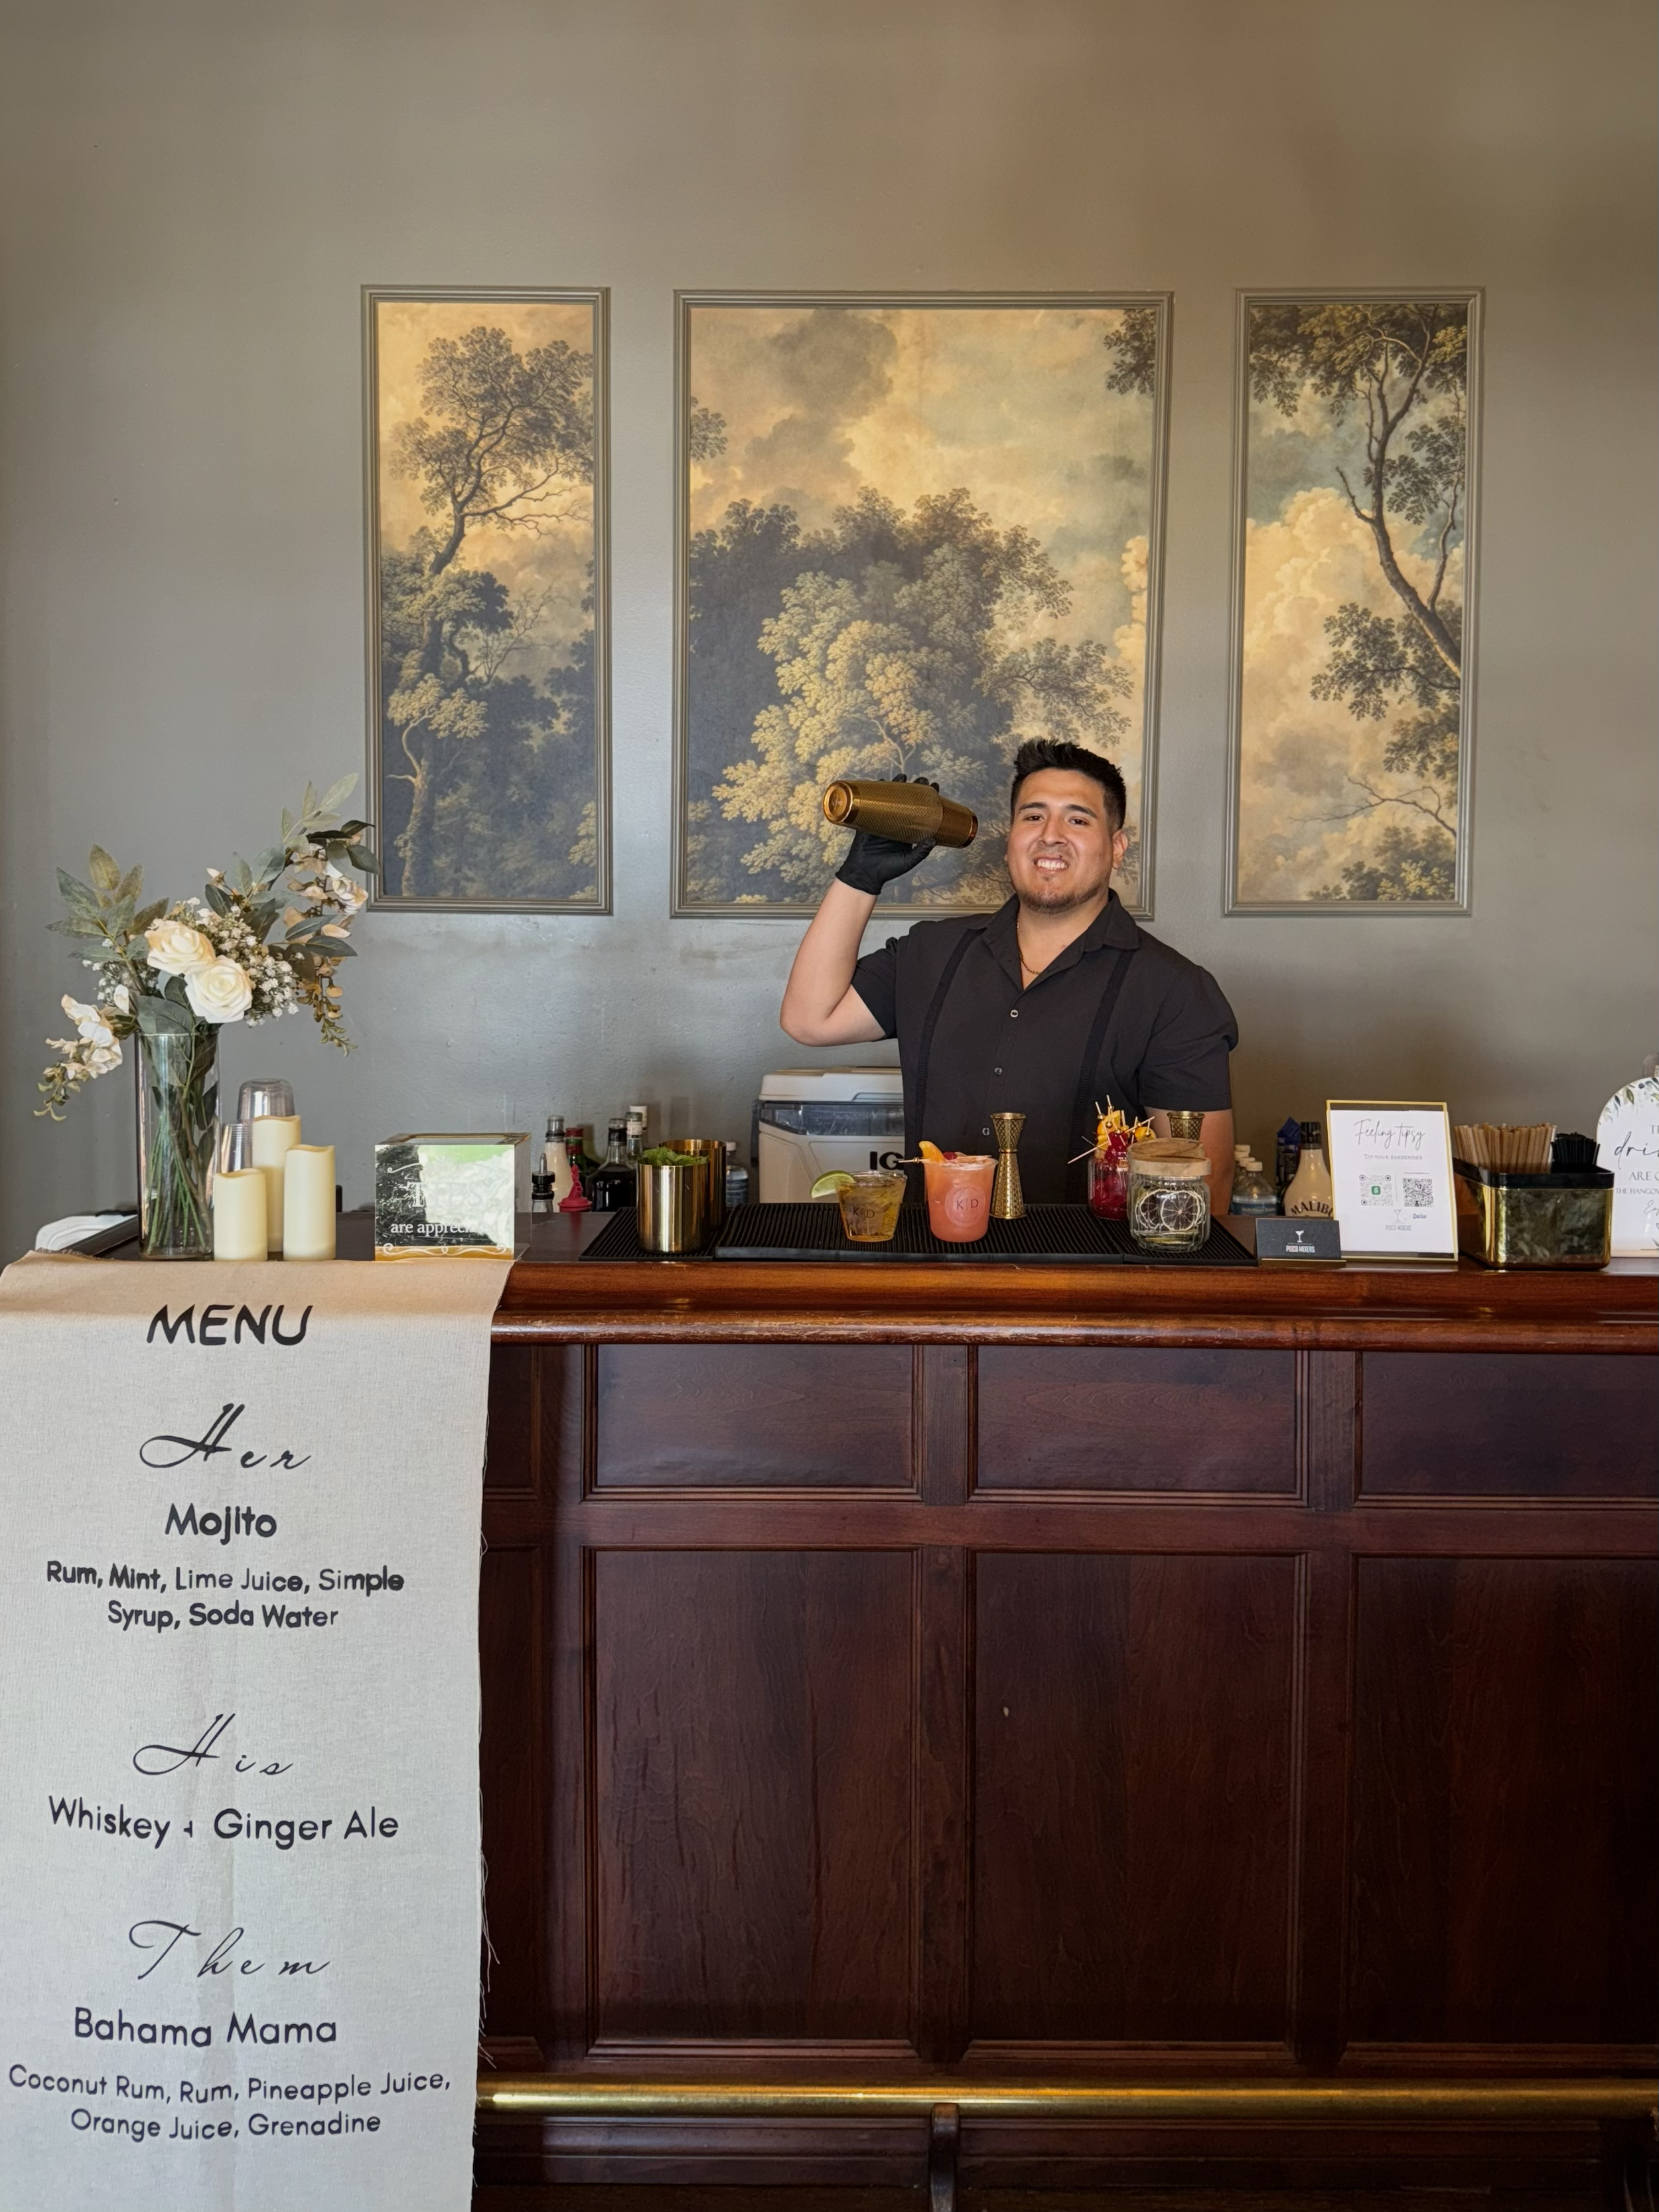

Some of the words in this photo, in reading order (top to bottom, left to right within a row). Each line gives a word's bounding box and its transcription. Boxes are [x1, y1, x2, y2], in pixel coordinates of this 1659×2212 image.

[1354, 1118, 1396, 1149] Feeling
[1615, 1131, 1659, 1170] dri
[1629, 1171, 1652, 1181] ARE
[390, 1223, 413, 1234] are
[147, 1304, 313, 1345] MENU
[140, 1404, 311, 1469] Her
[165, 1503, 277, 1545] Mojito
[47, 1561, 103, 1588] Rum,
[109, 1564, 167, 1593] Mint,
[176, 1567, 233, 1591] Lime
[241, 1568, 310, 1594] Juice,
[319, 1566, 405, 1597] Simple
[108, 1600, 180, 1633] Syrup,
[189, 1600, 254, 1626] Soda
[262, 1605, 338, 1628] Water
[133, 1714, 293, 1775] His
[48, 1795, 171, 1848] Whiskey
[214, 1808, 332, 1850] Ginger
[344, 1806, 399, 1840] Ale
[129, 1920, 330, 1980] Them
[75, 2007, 212, 2047] Bahama
[226, 2012, 336, 2044] Mama
[9, 2065, 107, 2095] Coconut
[116, 2075, 171, 2104] Rum,
[180, 2081, 239, 2104] Rum,
[248, 2075, 372, 2105] Pineapple
[380, 2072, 450, 2094] Juice,
[71, 2109, 161, 2142] Orange
[169, 2116, 239, 2139] Juice,
[248, 2111, 381, 2136] Grenadine
